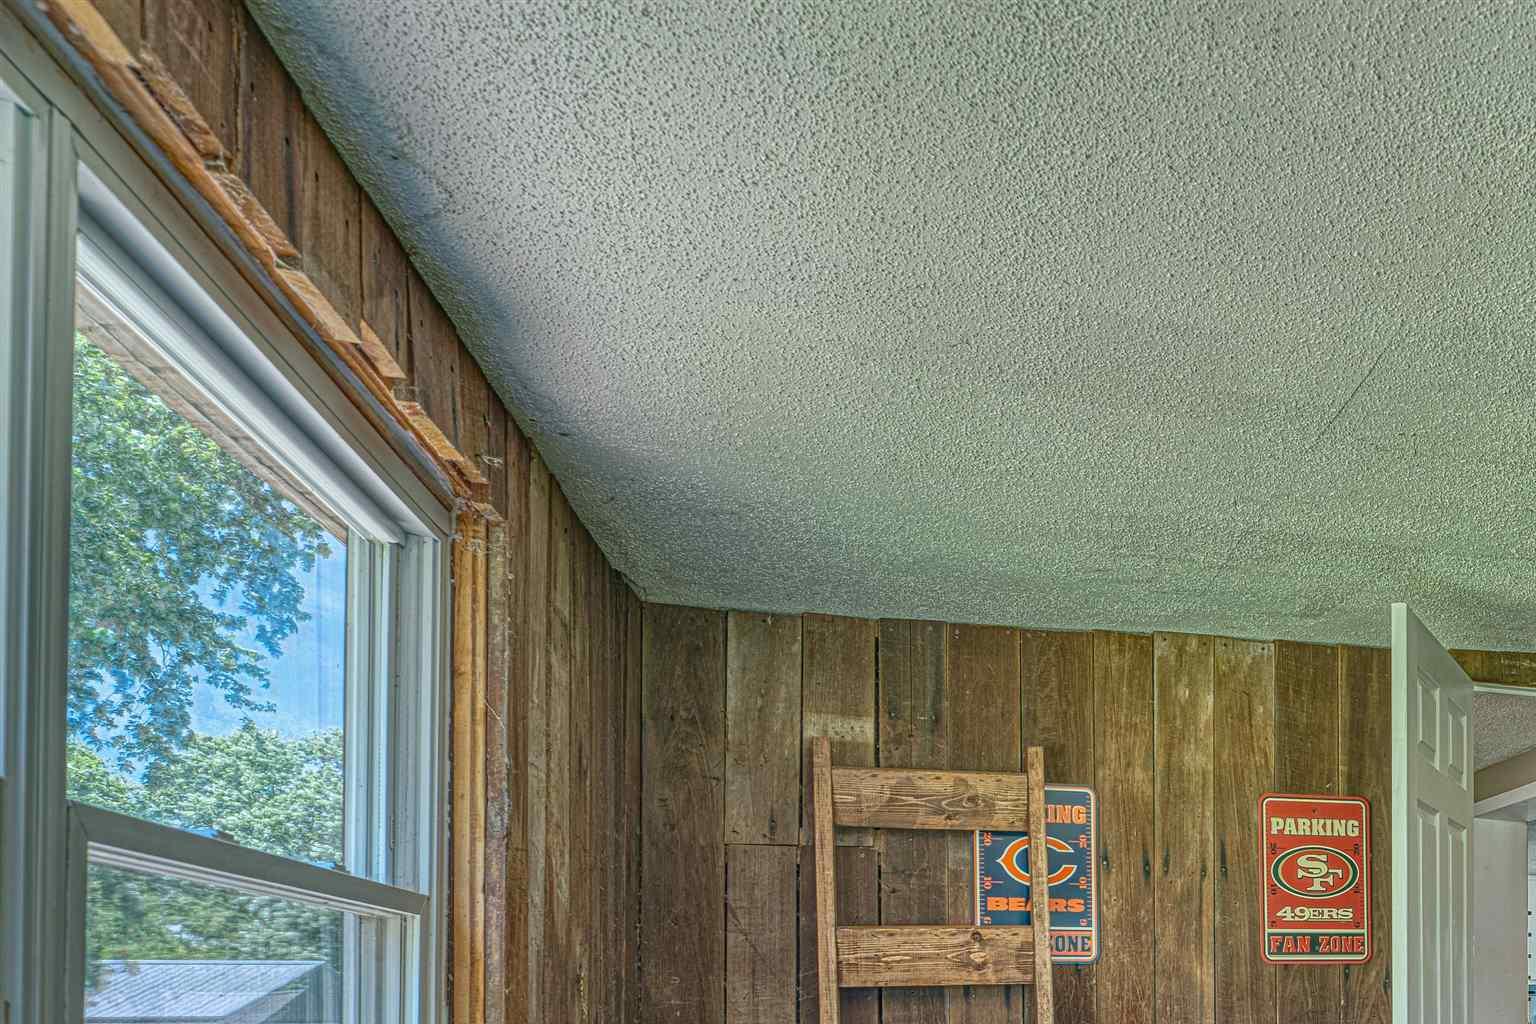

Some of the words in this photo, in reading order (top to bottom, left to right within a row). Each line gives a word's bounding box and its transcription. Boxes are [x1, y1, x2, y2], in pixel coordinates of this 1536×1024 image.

[1270, 816, 1360, 837] PARKING
[1296, 854, 1344, 891] SF
[1275, 906, 1354, 921] 49ERS
[1270, 935, 1312, 953] FAN
[1318, 935, 1364, 953] ZONE
